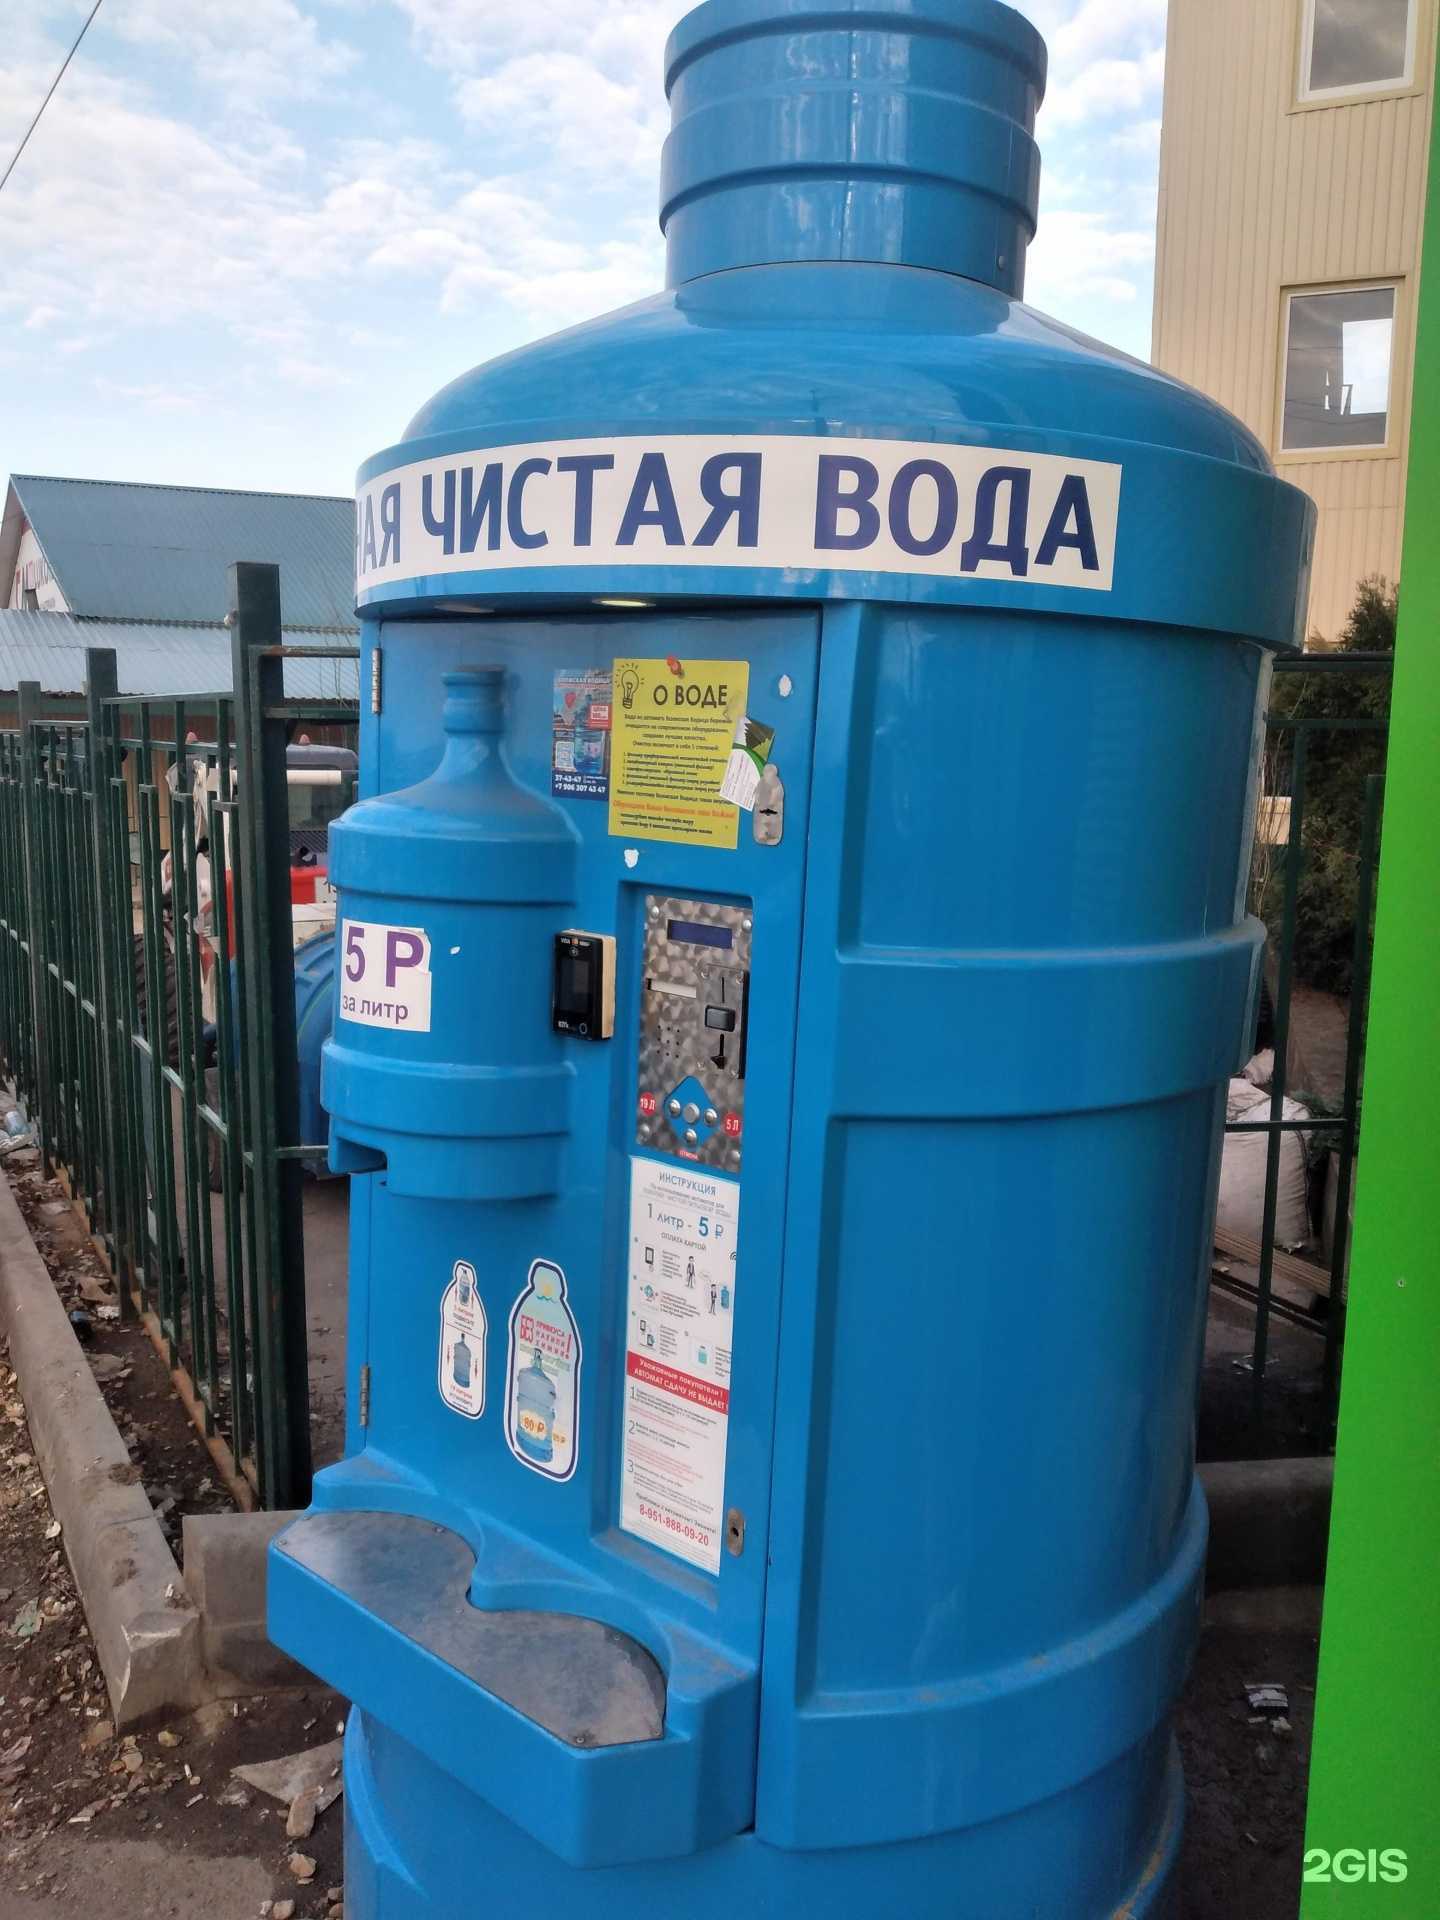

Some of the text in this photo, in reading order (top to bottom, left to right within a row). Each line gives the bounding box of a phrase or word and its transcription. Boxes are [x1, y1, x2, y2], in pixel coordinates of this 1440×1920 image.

[422, 452, 762, 557] ЧИСТАЯ
[815, 454, 1100, 577] ВОДА
[653, 685, 728, 708] О ВОДЕ
[346, 926, 424, 987] 5 Р
[343, 995, 408, 1024] за литр
[640, 1098, 648, 1108] 19
[726, 1119, 732, 1130] 5
[659, 1172, 716, 1196] ИНСТРУКЦИЯ
[648, 1203, 653, 1218] 1
[698, 1216, 709, 1236] 5
[520, 1314, 534, 1344] БЕЗ
[634, 1368, 663, 1384] АВТОМАТ
[664, 1380, 687, 1394] СДАЧУ
[688, 1391, 697, 1399] НЕ
[698, 1393, 724, 1410] ВЫДАЕТ
[629, 1420, 636, 1434] 2
[627, 1459, 634, 1473] 3
